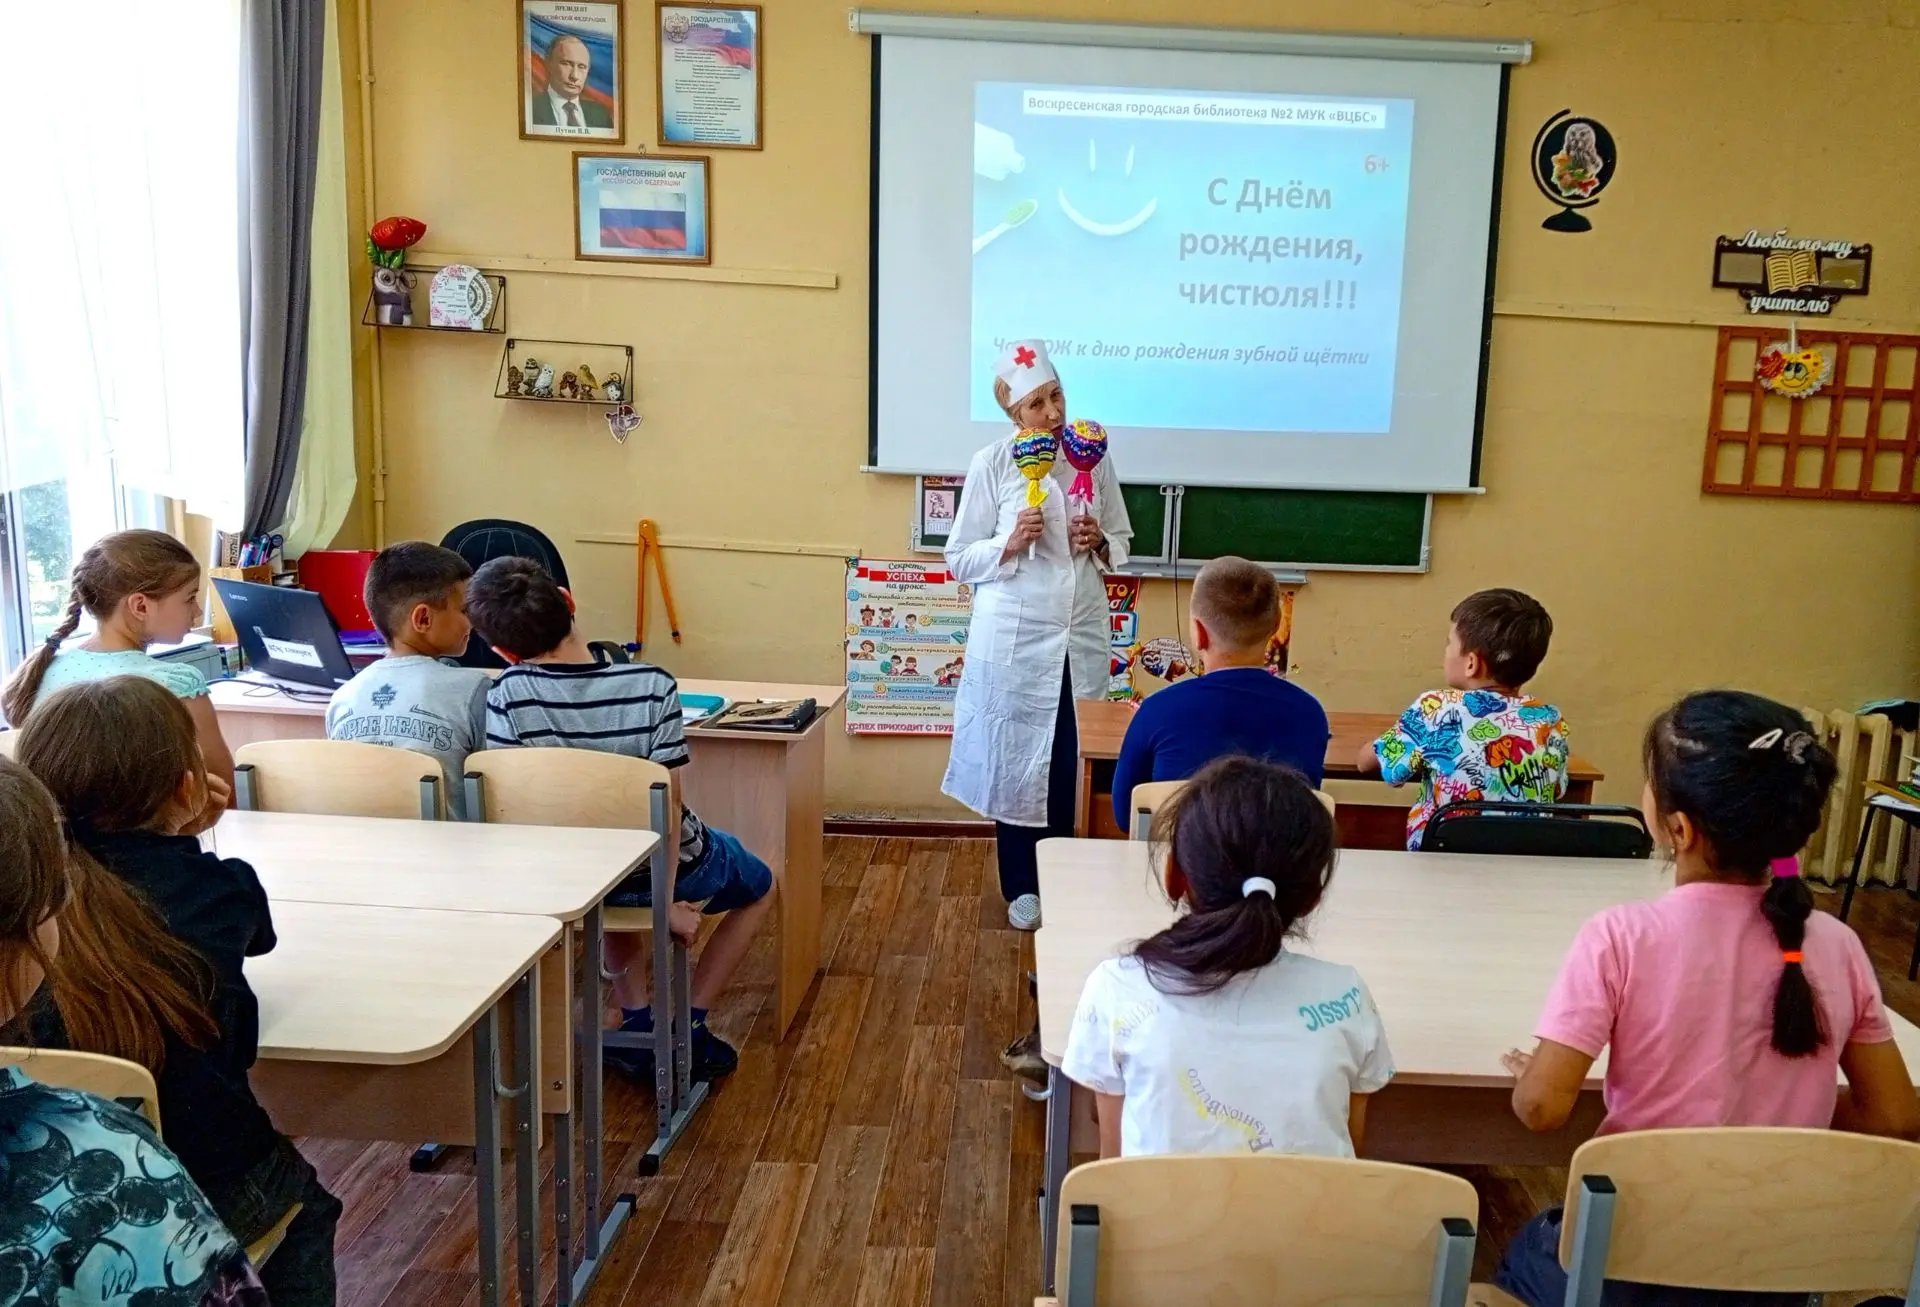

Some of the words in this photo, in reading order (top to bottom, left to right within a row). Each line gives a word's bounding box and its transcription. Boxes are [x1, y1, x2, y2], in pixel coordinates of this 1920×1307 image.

[1028, 97, 1122, 112] Воскресенская
[1126, 103, 1189, 116] городская
[1193, 104, 1267, 118] библиотека
[1271, 107, 1293, 120] №2
[1297, 109, 1326, 121] МУК
[1329, 111, 1377, 124] «ВЦБС»
[596, 168, 666, 178] ГОСУДАРСТВЕННЫЙ
[668, 171, 687, 179] ФЛАГ
[1364, 154, 1390, 174] 6+
[1207, 178, 1228, 206] С
[1236, 179, 1332, 214] Днём
[1179, 232, 1363, 266] рождения,
[1737, 228, 1853, 259] Любимому
[1179, 280, 1357, 309] чистюля!!!
[1750, 296, 1830, 314] учителю
[1076, 343, 1088, 356] к
[1091, 340, 1130, 358] дню
[1134, 342, 1229, 361] рождения
[1233, 345, 1299, 365] зубной
[1303, 348, 1369, 367] щётки
[886, 572, 926, 581] УСПЕХА
[888, 562, 927, 571] Секреты
[334, 715, 381, 740] APLE
[384, 715, 453, 751] LEAFS
[848, 723, 875, 731] УСПЕХ
[877, 723, 924, 732] ПРИХОДИТ
